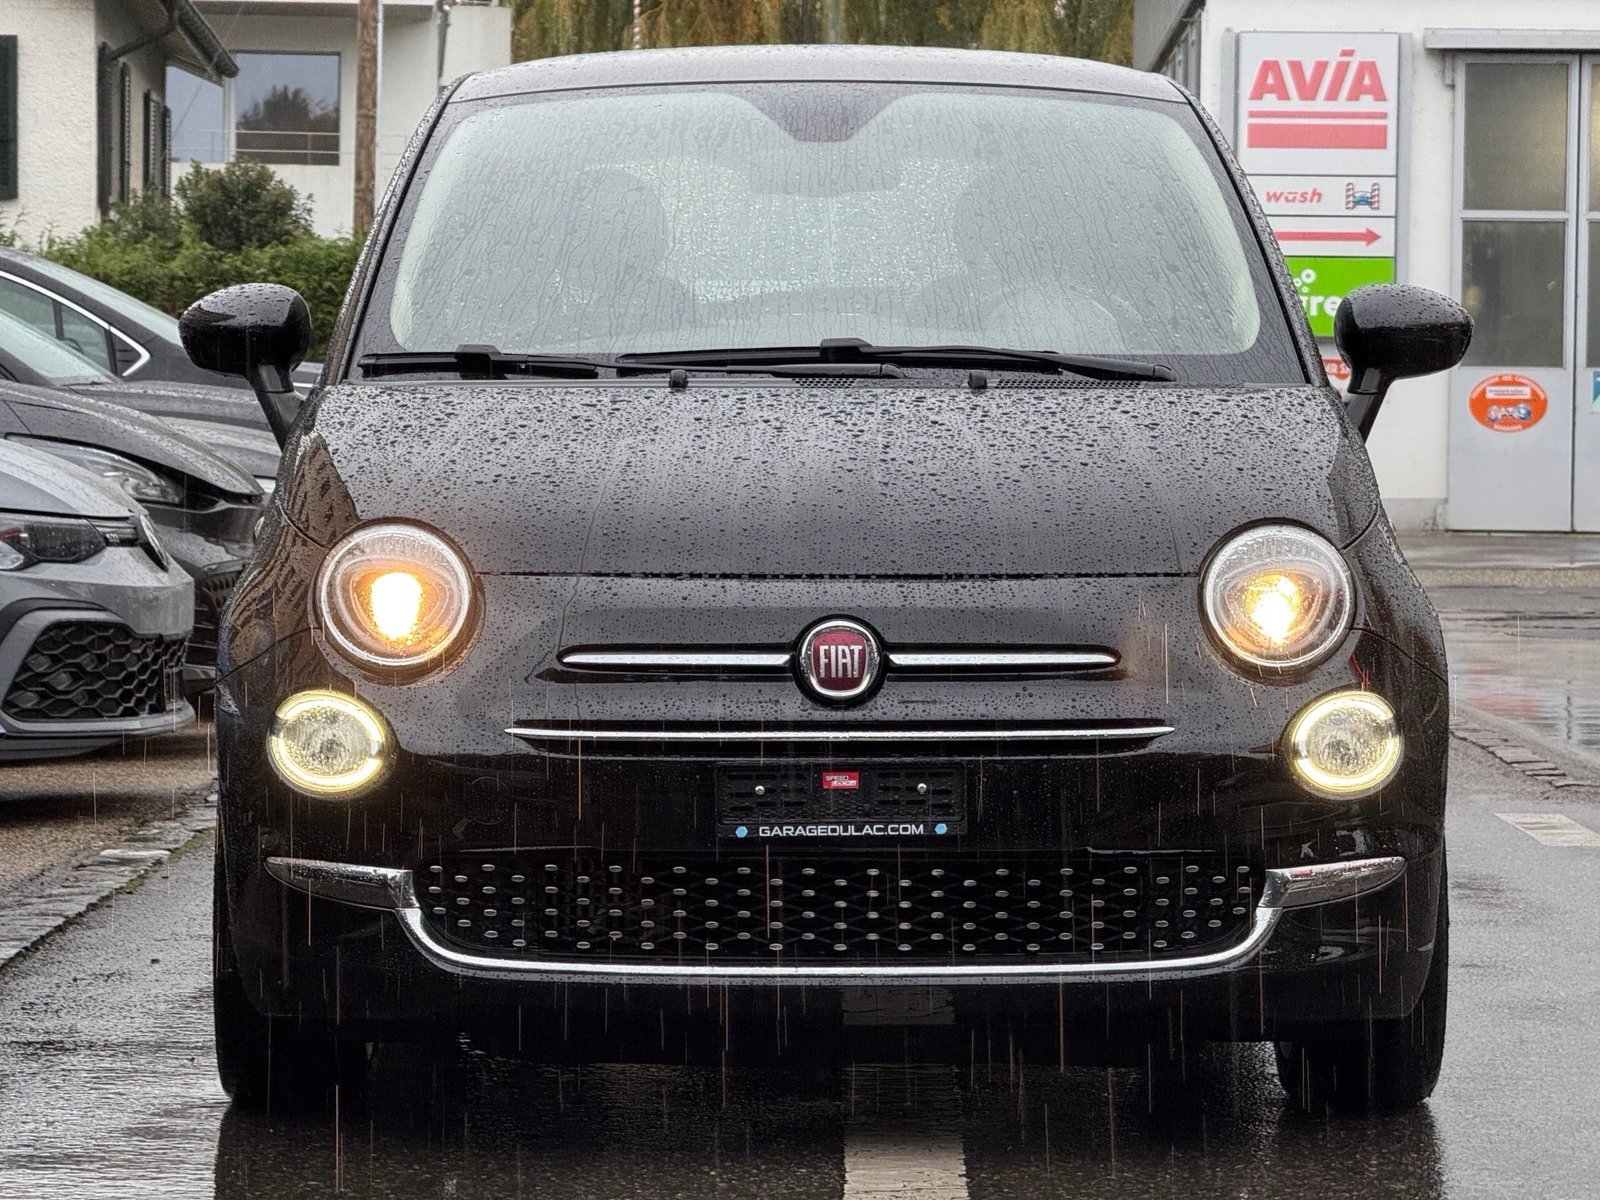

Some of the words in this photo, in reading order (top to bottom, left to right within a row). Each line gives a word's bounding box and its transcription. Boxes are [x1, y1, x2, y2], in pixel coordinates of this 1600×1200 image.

[1265, 187, 1322, 204] wash
[819, 645, 862, 678] FIAT
[759, 823, 924, 836] GARAGEDULAC.COM
